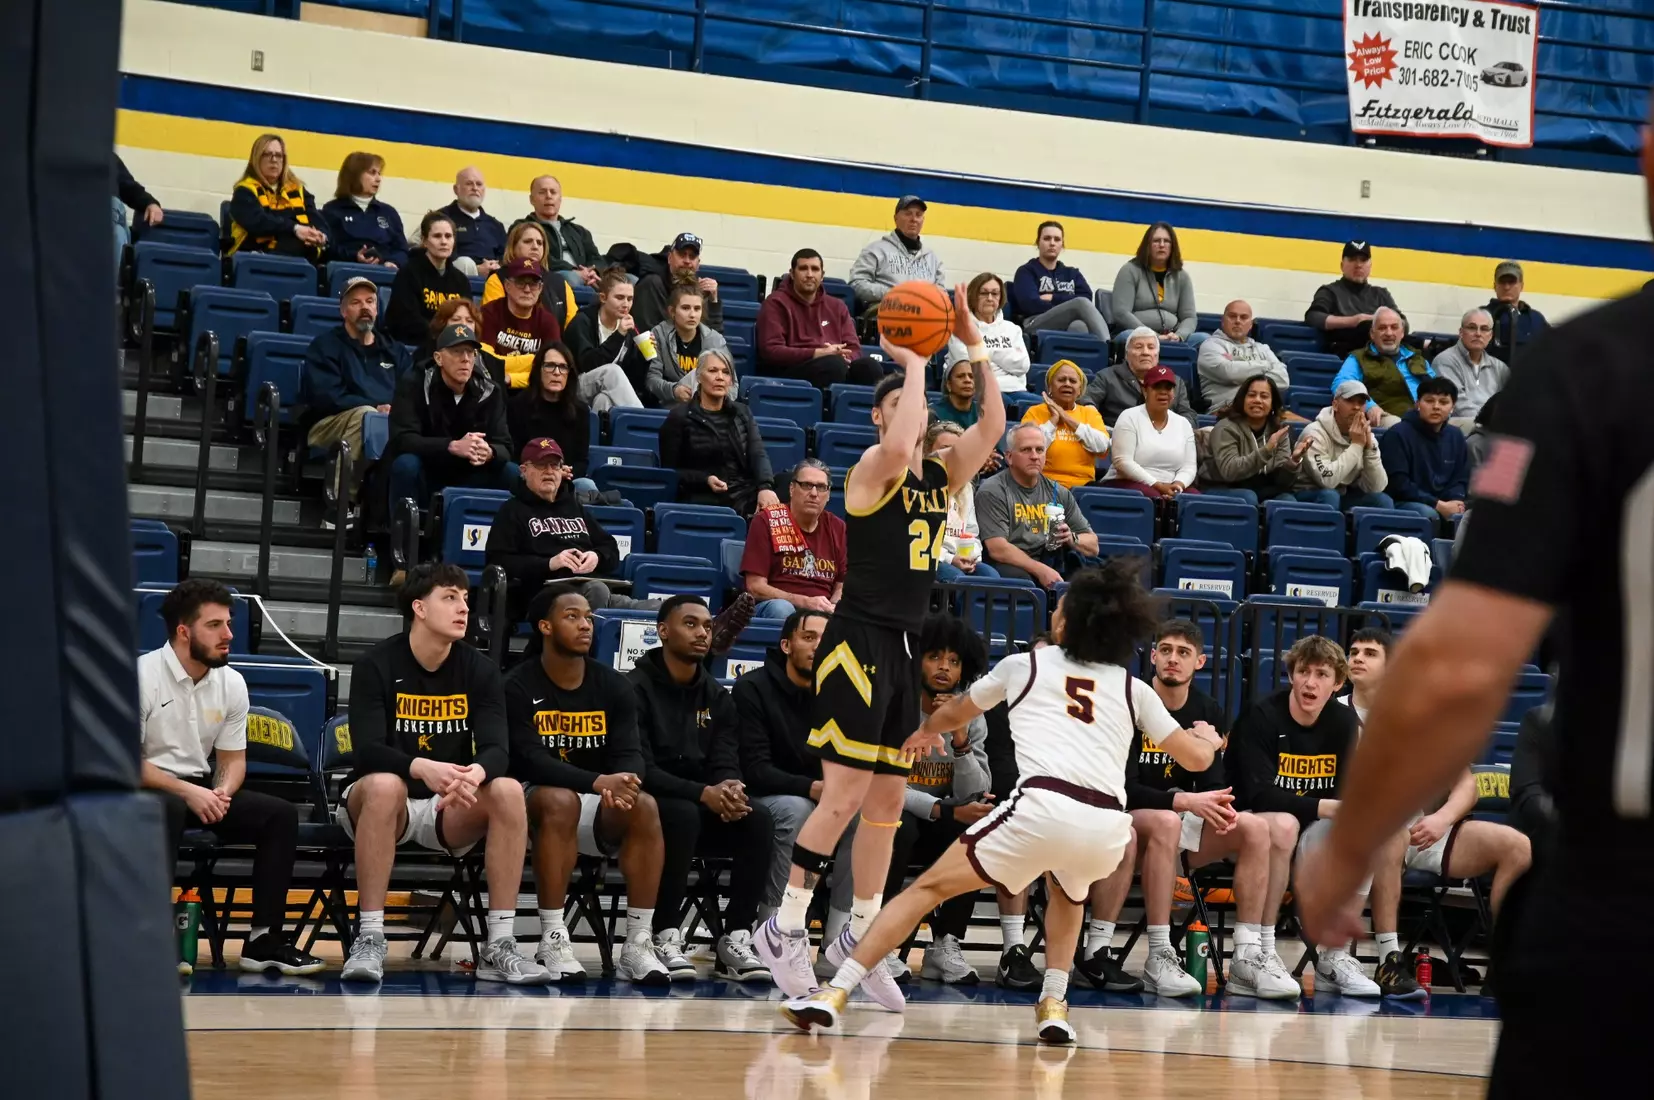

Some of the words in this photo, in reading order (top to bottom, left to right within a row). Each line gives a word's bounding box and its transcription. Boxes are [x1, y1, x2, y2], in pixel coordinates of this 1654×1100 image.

[1353, 0, 1469, 28] Transparency
[1472, 10, 1485, 28] &
[1490, 8, 1531, 35] Trust
[1356, 45, 1386, 57] Always
[1404, 40, 1433, 60] ERIC
[1439, 42, 1478, 66] COOK
[1363, 66, 1386, 77] Price
[1364, 57, 1382, 66] Low
[1355, 99, 1475, 128] Fitzgerald
[529, 517, 590, 537] GANNON
[396, 697, 466, 718] KNIGHTS
[1064, 676, 1096, 725] 5
[535, 713, 604, 733] KNGHTS
